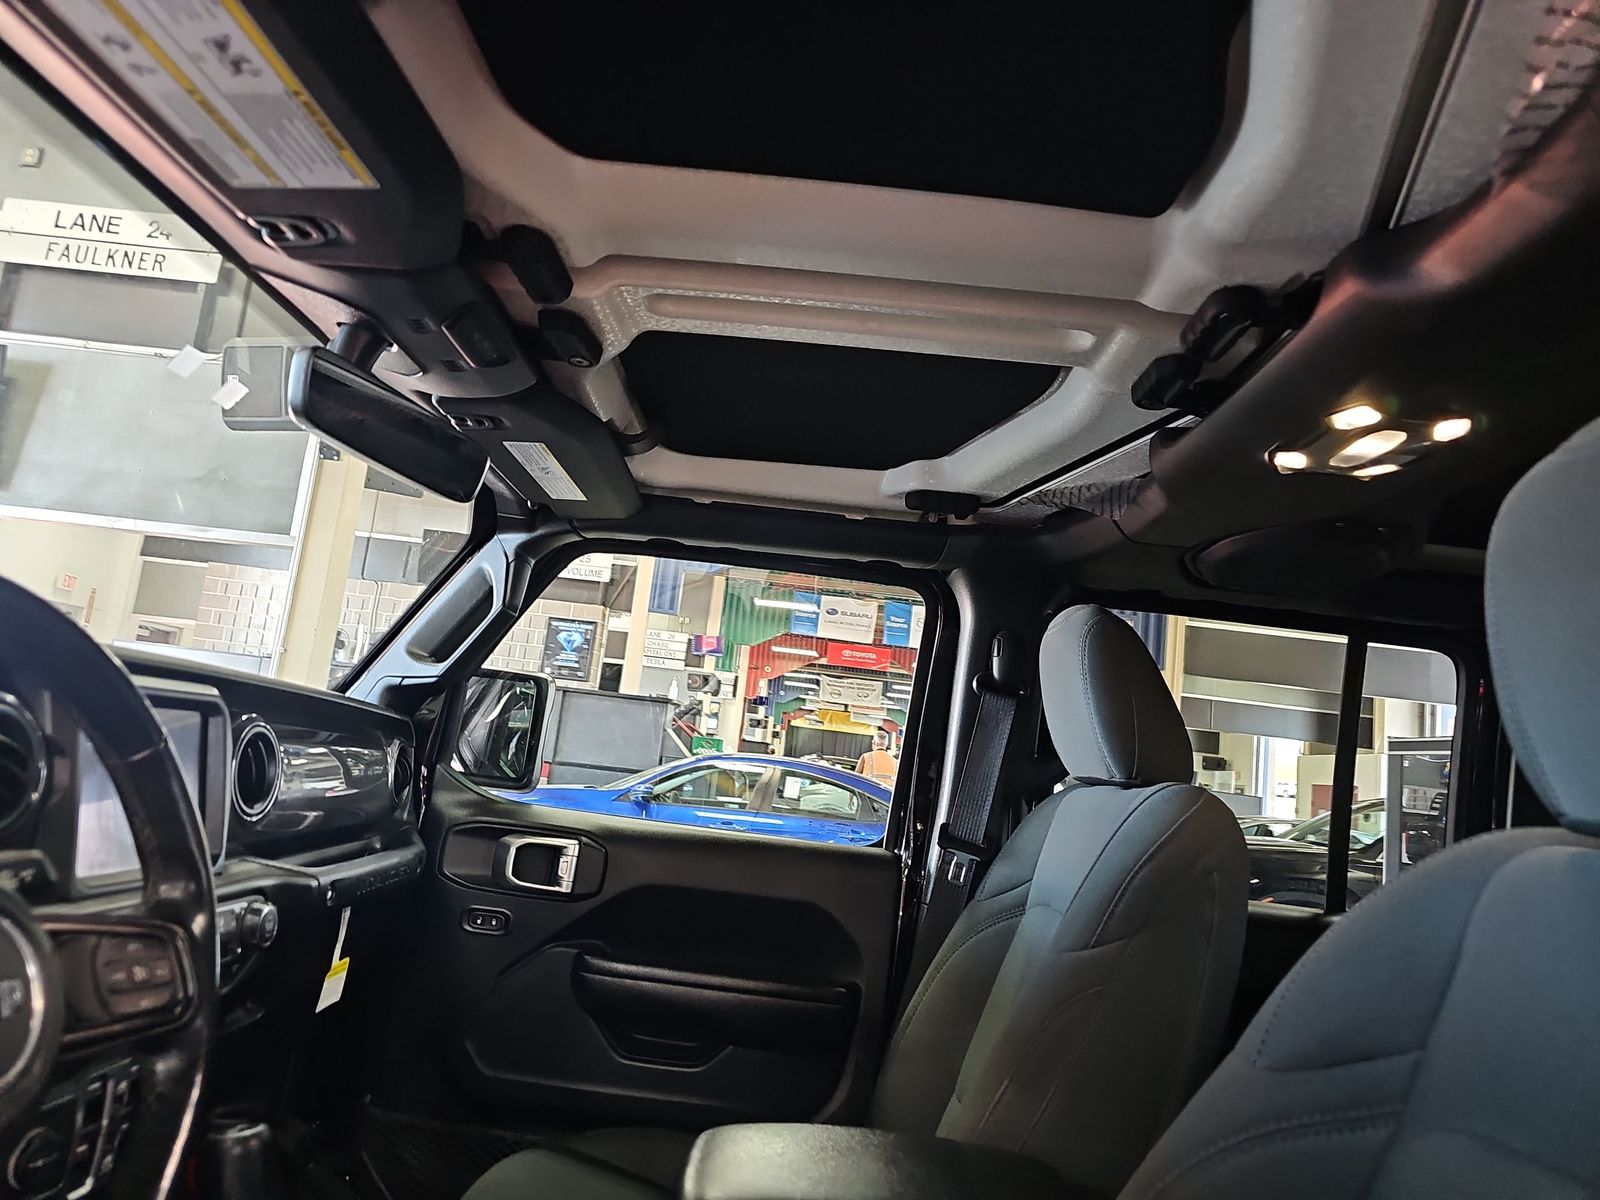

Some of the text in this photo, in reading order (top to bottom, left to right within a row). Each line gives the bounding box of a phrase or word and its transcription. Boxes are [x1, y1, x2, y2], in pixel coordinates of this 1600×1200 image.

[53, 209, 123, 235] LANE
[44, 241, 167, 273] FAULKNER
[567, 566, 603, 578] VOLUME
[840, 610, 873, 620] SUBARU
[852, 651, 877, 659] TOYOTA
[646, 657, 667, 666] TESLA
